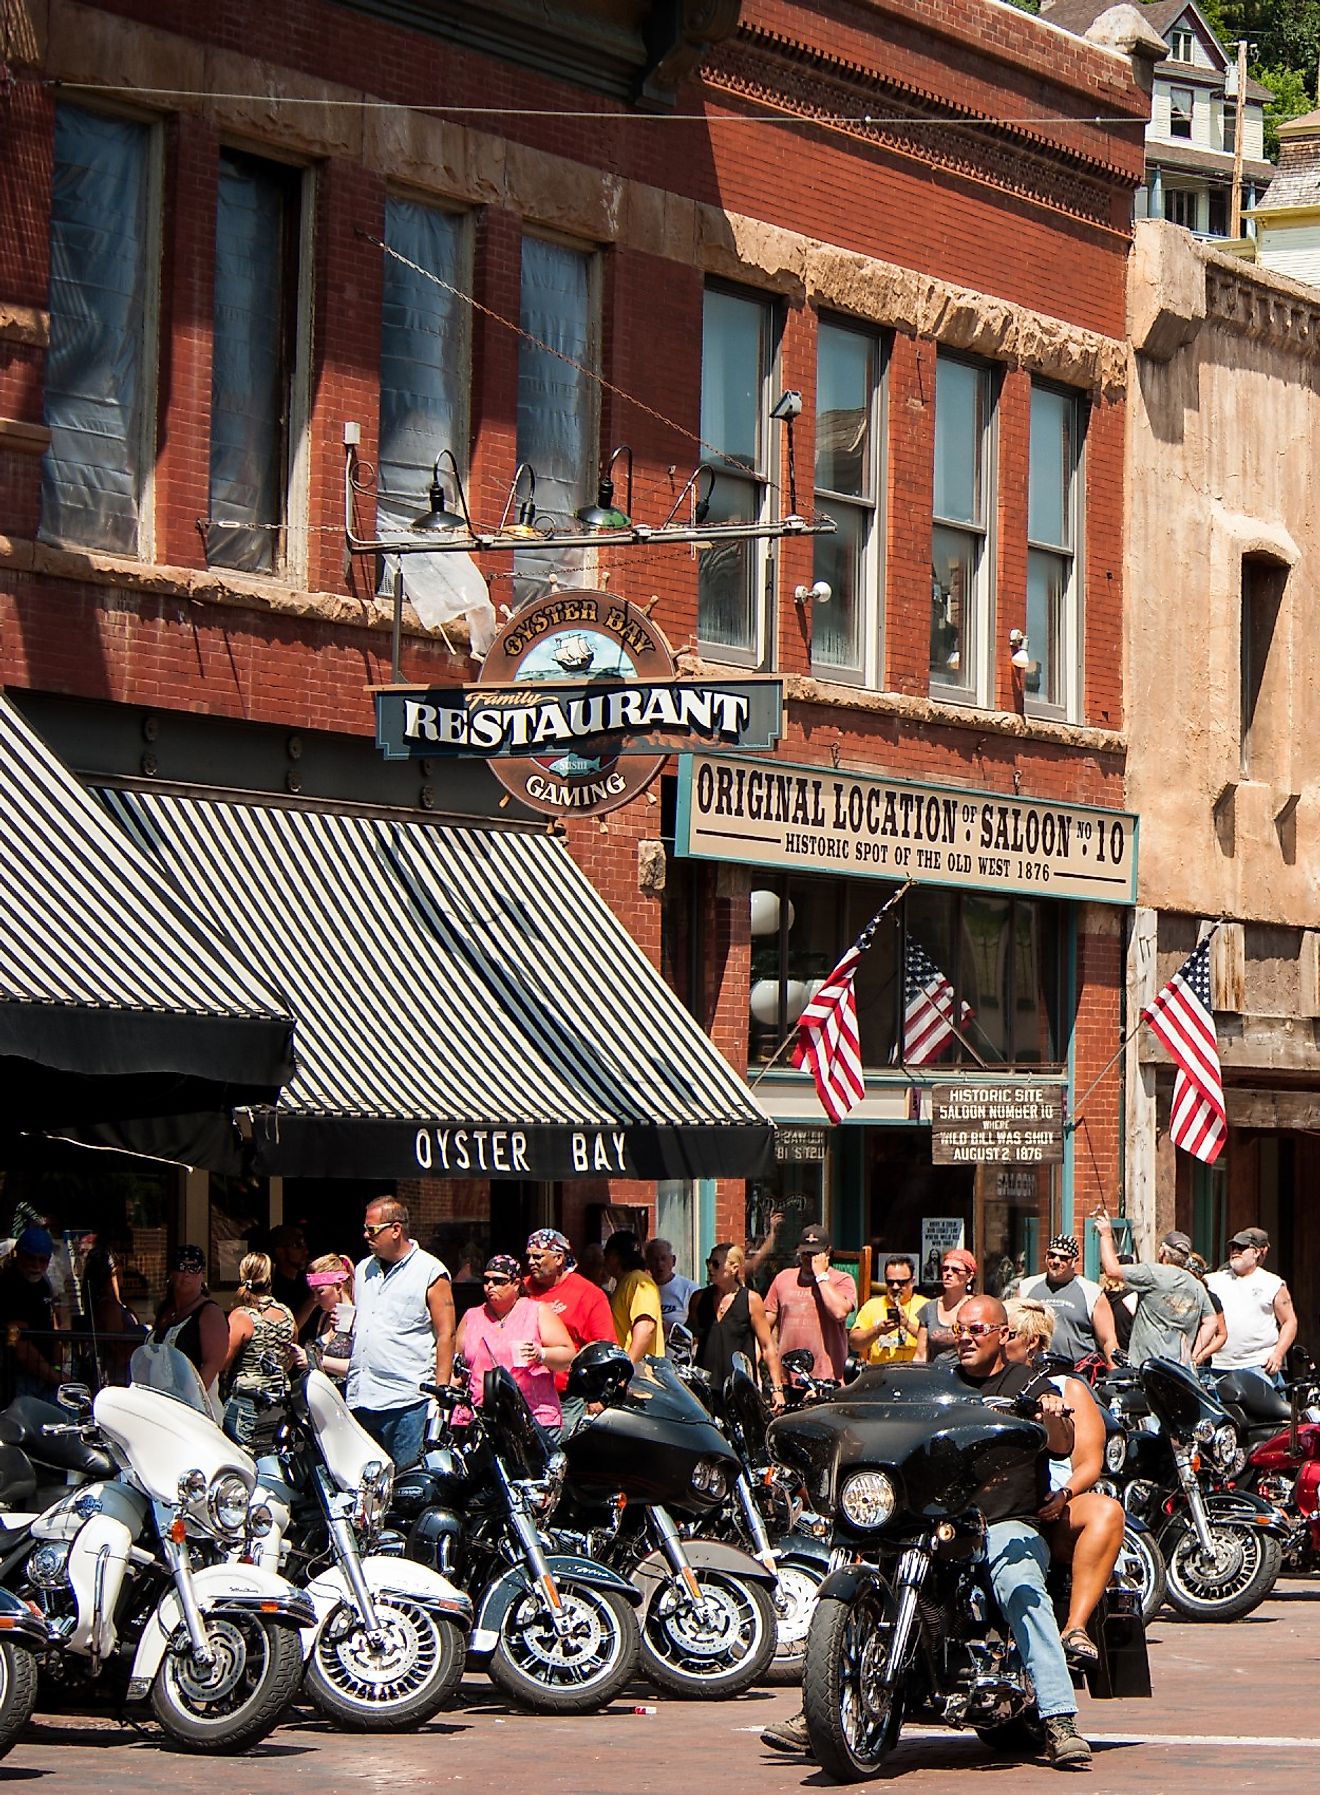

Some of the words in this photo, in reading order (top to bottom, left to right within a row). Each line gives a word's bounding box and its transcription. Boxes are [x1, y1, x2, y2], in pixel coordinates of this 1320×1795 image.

[504, 599, 599, 657] OYSTER
[605, 607, 656, 656] BAY
[466, 689, 558, 708] Family
[404, 688, 749, 748] RESTAURANT
[525, 773, 627, 807] GAMING
[696, 763, 825, 827] ORIGINAL
[833, 781, 958, 844] LOCATION
[962, 804, 978, 824] OF
[980, 805, 1073, 858] SALOON
[1097, 820, 1124, 865] 10
[784, 832, 850, 861] HISTORIC
[855, 840, 888, 864] SPOT
[894, 847, 911, 867] OF
[917, 848, 942, 870] THE
[947, 851, 972, 874] OLD
[978, 857, 1011, 878] WEST
[1017, 860, 1050, 882] 1876
[949, 1088, 1012, 1103] HISTORIC
[1015, 1088, 1044, 1103] SITE
[939, 1104, 986, 1120] SALOON
[989, 1104, 1038, 1119] NUMBER
[1040, 1104, 1053, 1120] 10
[982, 1120, 1010, 1130] WHERE
[415, 1128, 531, 1172] OYSTER
[571, 1132, 628, 1172] BAY
[940, 1131, 968, 1146] WILD
[970, 1131, 996, 1145] BILL
[996, 1131, 1023, 1145] WAS
[1025, 1131, 1055, 1145] SHOT
[953, 1146, 1000, 1161] AUGUST
[1015, 1146, 1043, 1161] 1876
